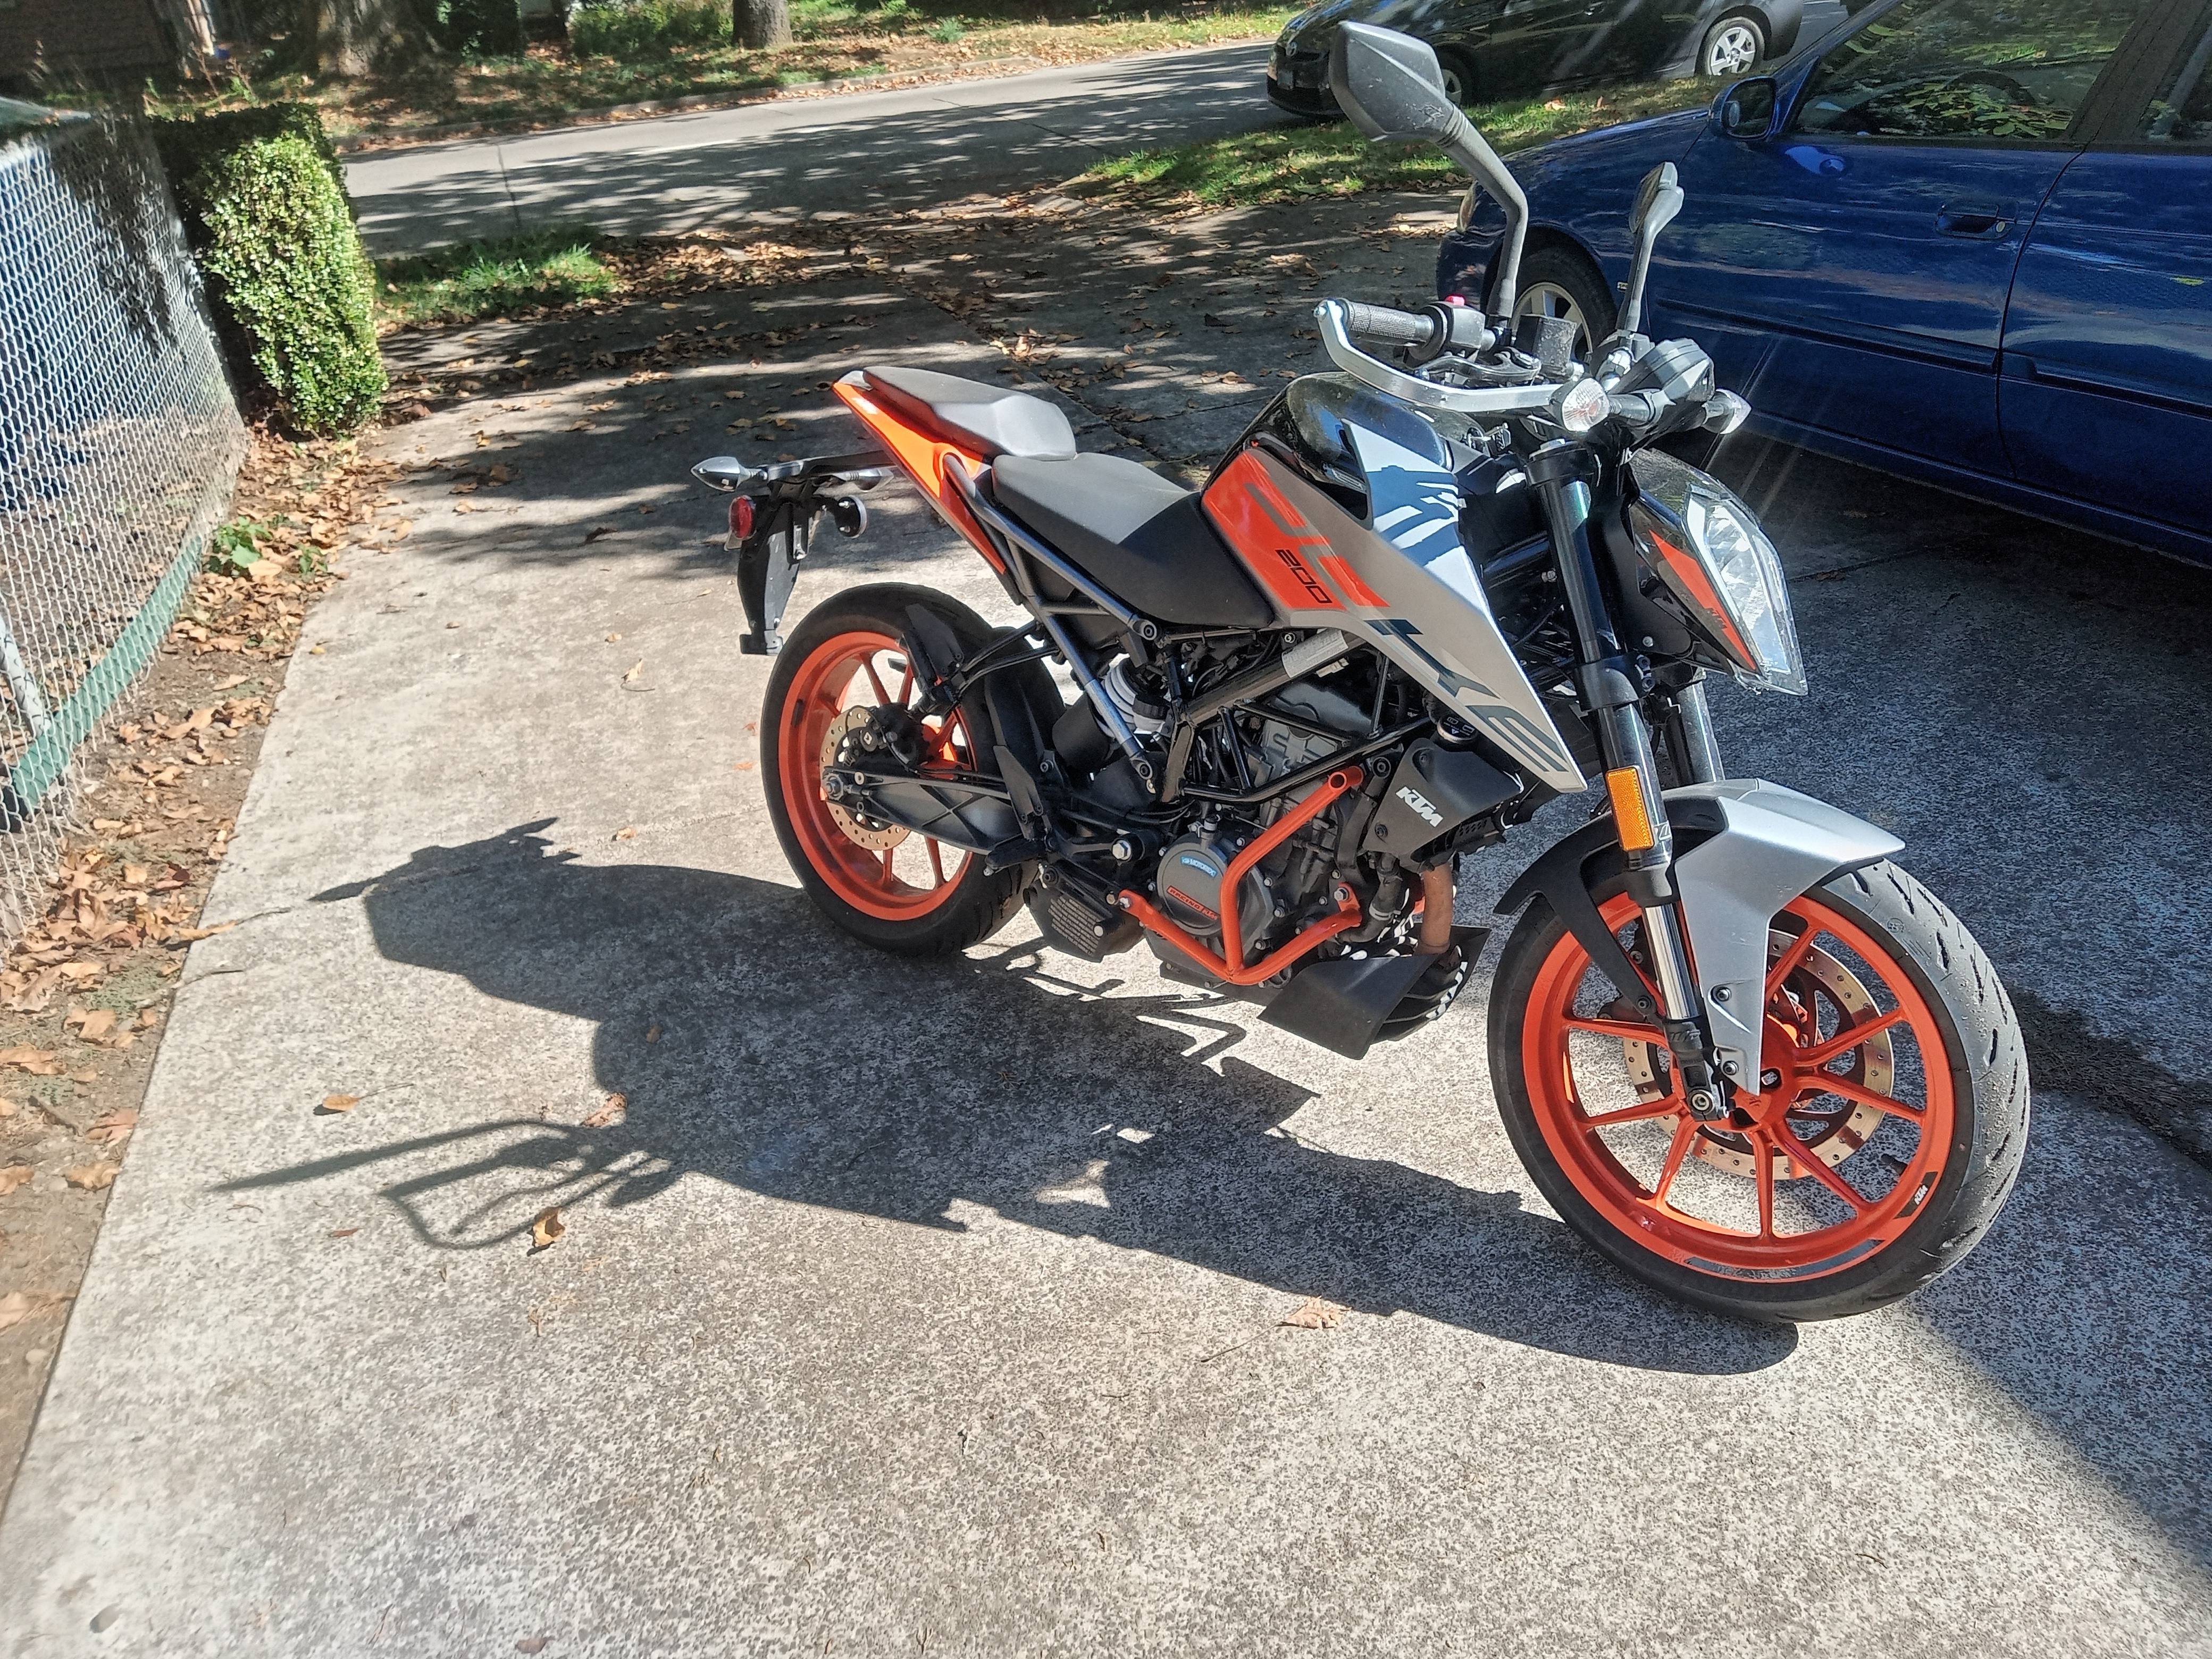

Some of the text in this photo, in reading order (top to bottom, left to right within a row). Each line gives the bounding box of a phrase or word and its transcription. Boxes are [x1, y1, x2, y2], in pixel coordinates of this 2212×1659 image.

[1275, 549, 1333, 603] 200
[1396, 786, 1443, 827] KTM
[1170, 889, 1201, 910] RACING
